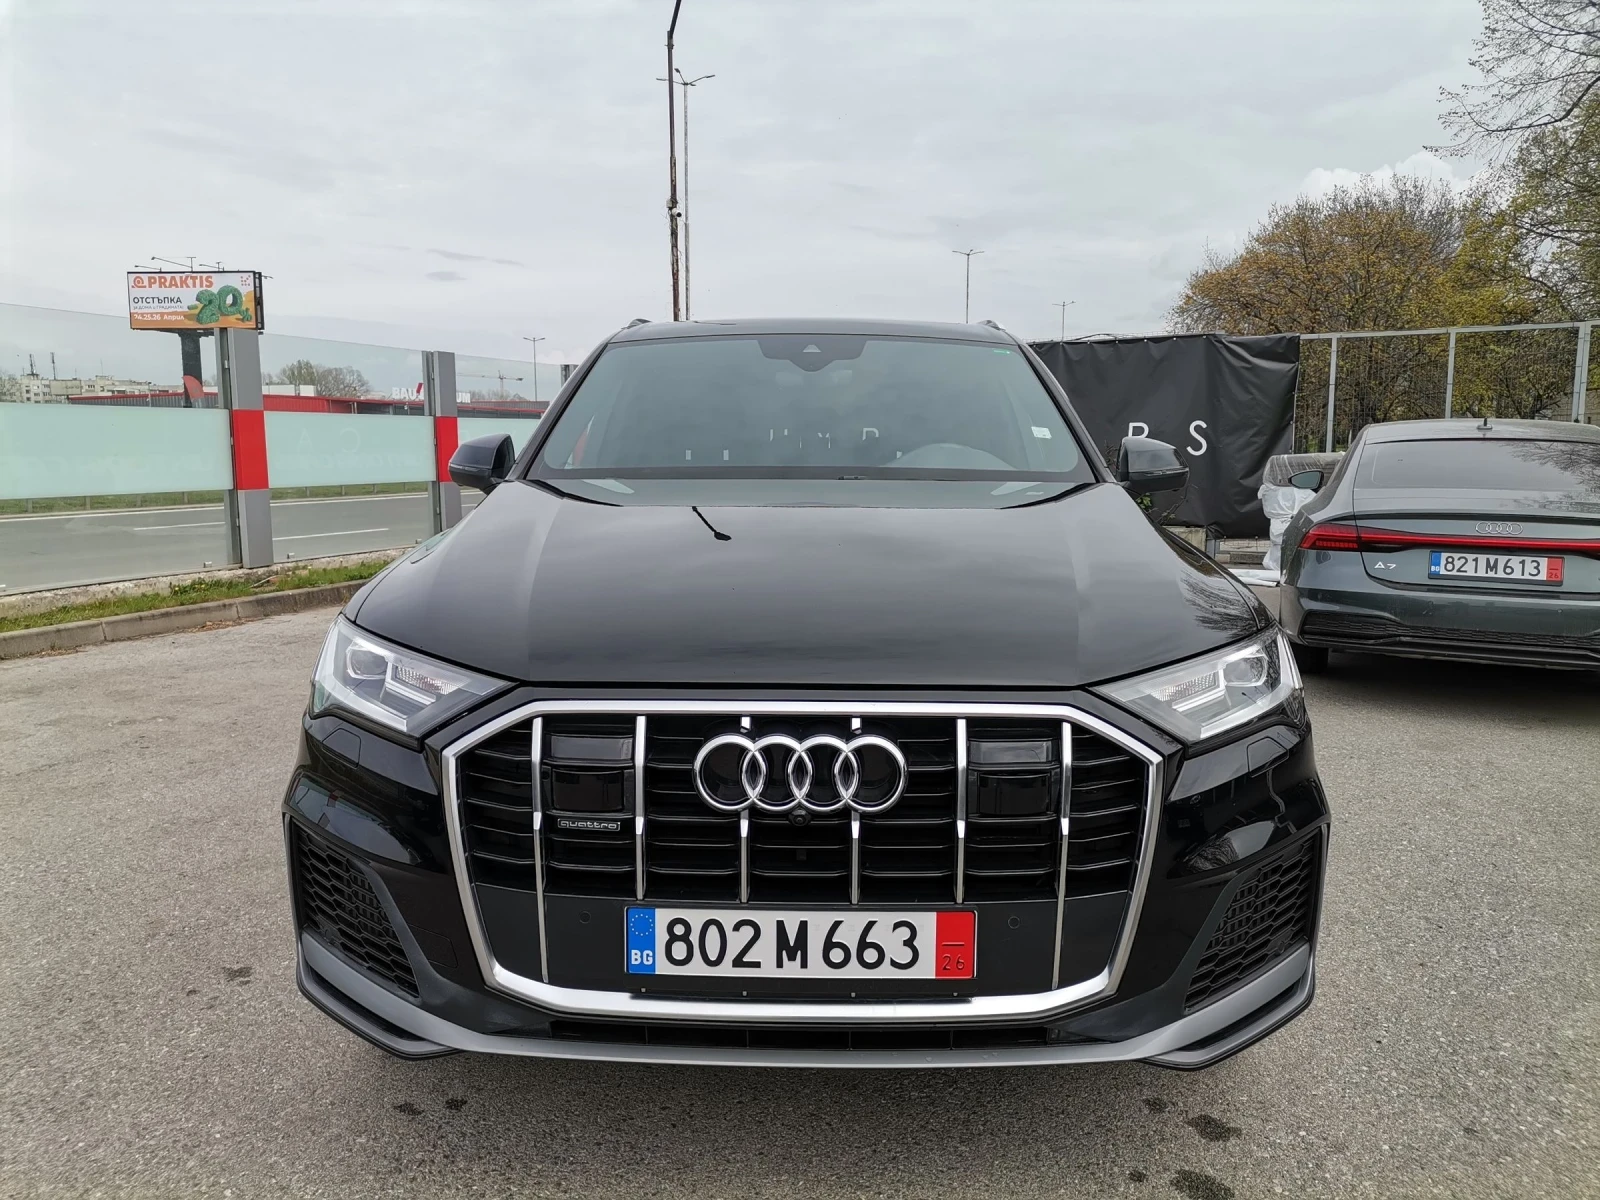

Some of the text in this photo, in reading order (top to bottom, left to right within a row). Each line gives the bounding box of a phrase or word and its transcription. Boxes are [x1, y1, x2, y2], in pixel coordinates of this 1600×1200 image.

[148, 275, 214, 289] PRAKTIS
[132, 296, 183, 304] ОТСТЪПКА
[1374, 561, 1397, 570] A7
[560, 820, 617, 829] quattro
[630, 949, 654, 966] BG
[942, 953, 965, 970] 26
